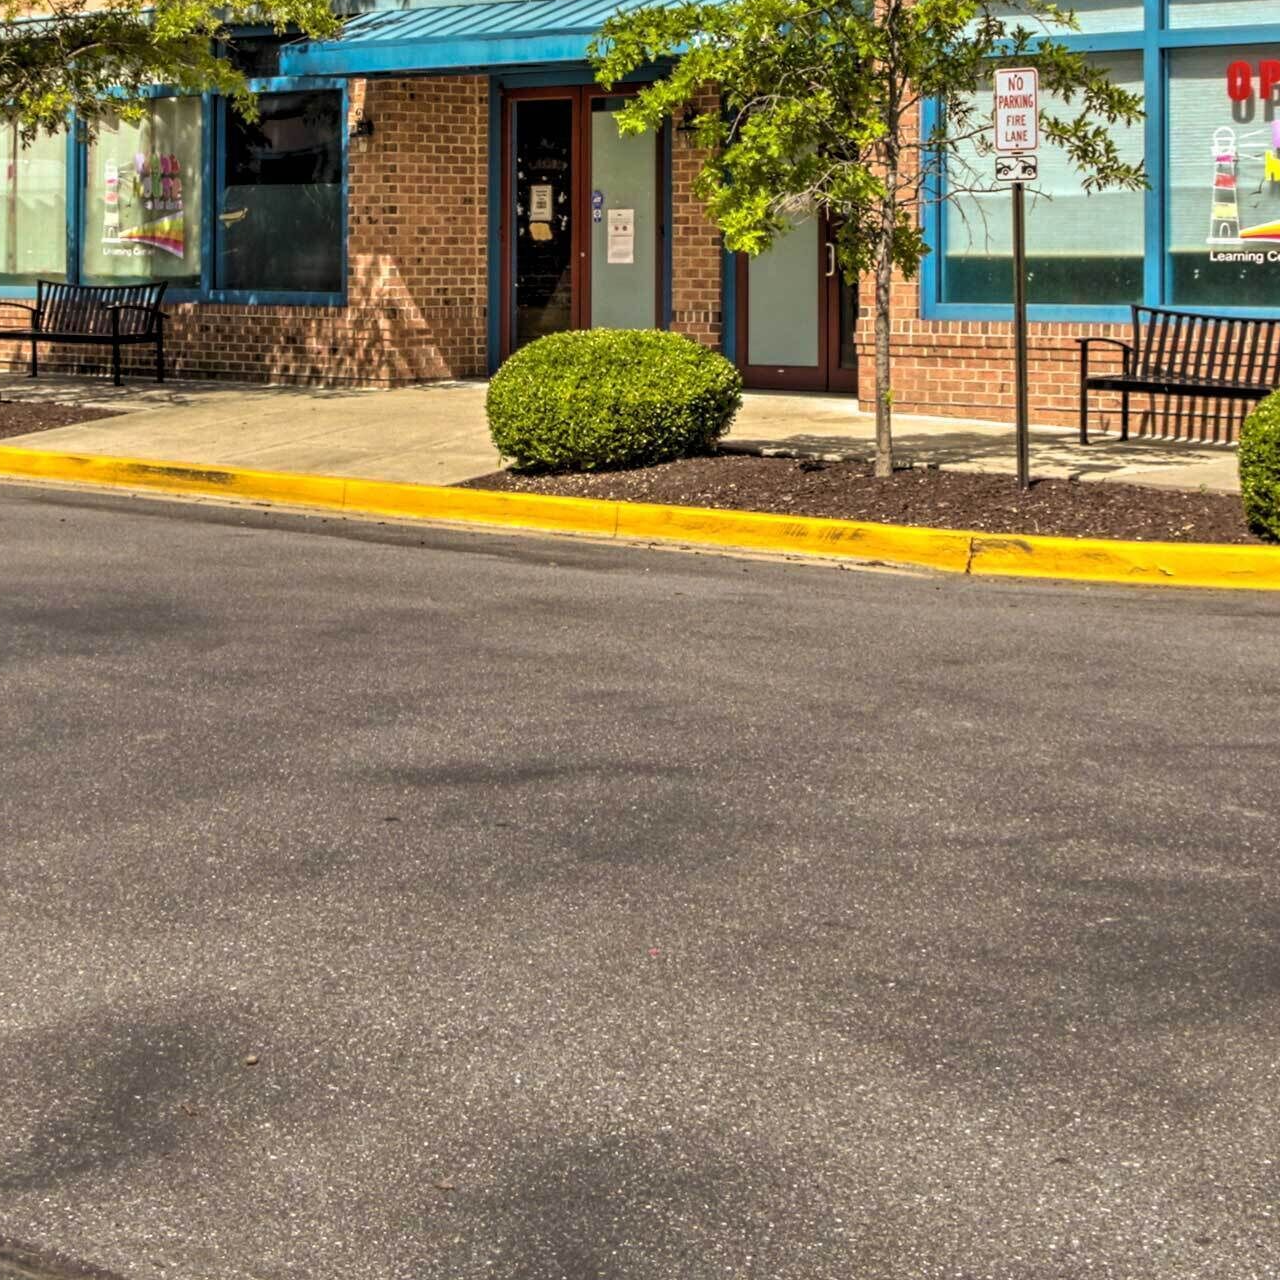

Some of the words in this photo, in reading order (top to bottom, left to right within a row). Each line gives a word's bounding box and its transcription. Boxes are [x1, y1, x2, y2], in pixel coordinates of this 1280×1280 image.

[1008, 77, 1023, 91] NO
[999, 94, 1033, 109] PARKING
[1006, 115, 1026, 126] FIRE
[1005, 130, 1028, 142] LANE
[1209, 250, 1264, 264] Learning
